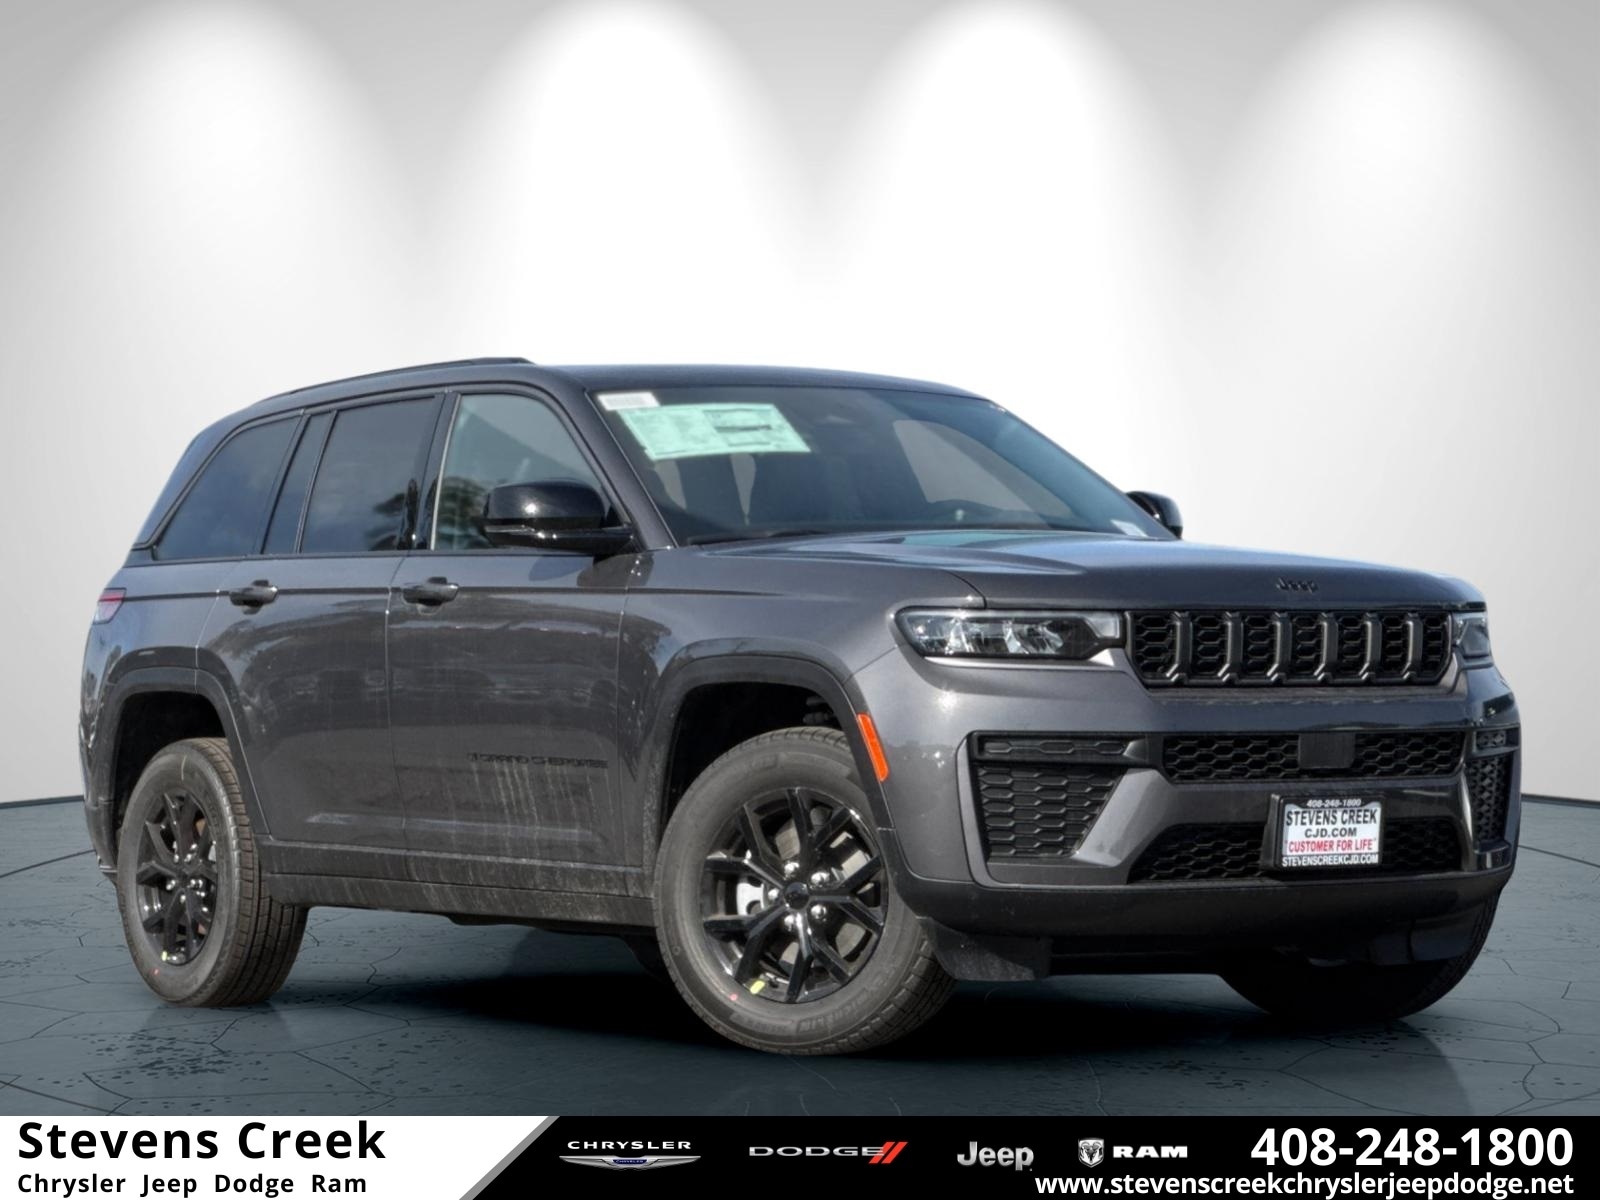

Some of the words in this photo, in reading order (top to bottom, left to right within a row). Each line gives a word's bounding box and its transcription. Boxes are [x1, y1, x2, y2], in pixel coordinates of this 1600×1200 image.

[1306, 798, 1362, 808] 408-248-1800
[1286, 810, 1337, 826] STEVENS
[1341, 808, 1378, 825] CREEK
[1304, 827, 1357, 838] CJD.COM
[1288, 840, 1334, 853] CUSTOMER
[1336, 839, 1353, 852] FOR
[1355, 839, 1373, 851] LIFE
[1281, 853, 1379, 867] STEVENSCREEKCJD.COM
